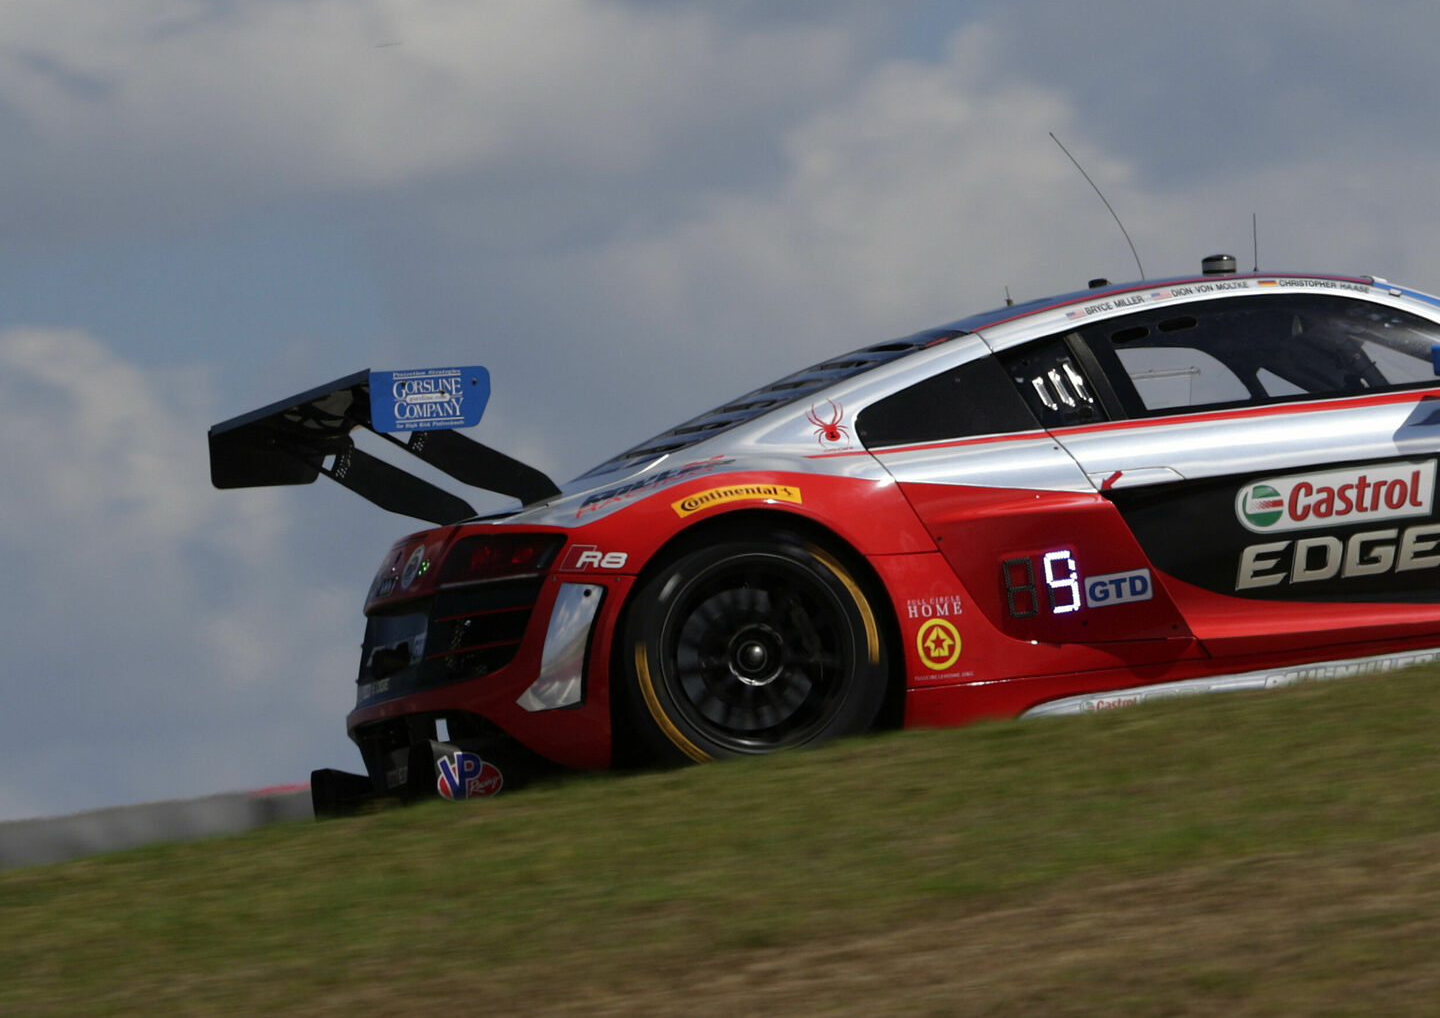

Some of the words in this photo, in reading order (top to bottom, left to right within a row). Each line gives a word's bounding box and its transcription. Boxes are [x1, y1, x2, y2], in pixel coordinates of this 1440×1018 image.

[1170, 287, 1193, 297] DION
[1195, 284, 1213, 293] VON
[1279, 279, 1336, 288] CHRISTOPHER
[1084, 303, 1113, 315] BRYCE
[1114, 295, 1144, 308] MILLER
[392, 378, 464, 399] GORSLINE
[394, 397, 464, 420] COMPANY
[680, 485, 779, 512] Continental
[1287, 469, 1423, 522] Castrol
[576, 550, 628, 569] R8
[1088, 574, 1149, 603] GTD
[907, 601, 963, 619] HOME
[437, 751, 483, 800] VP
